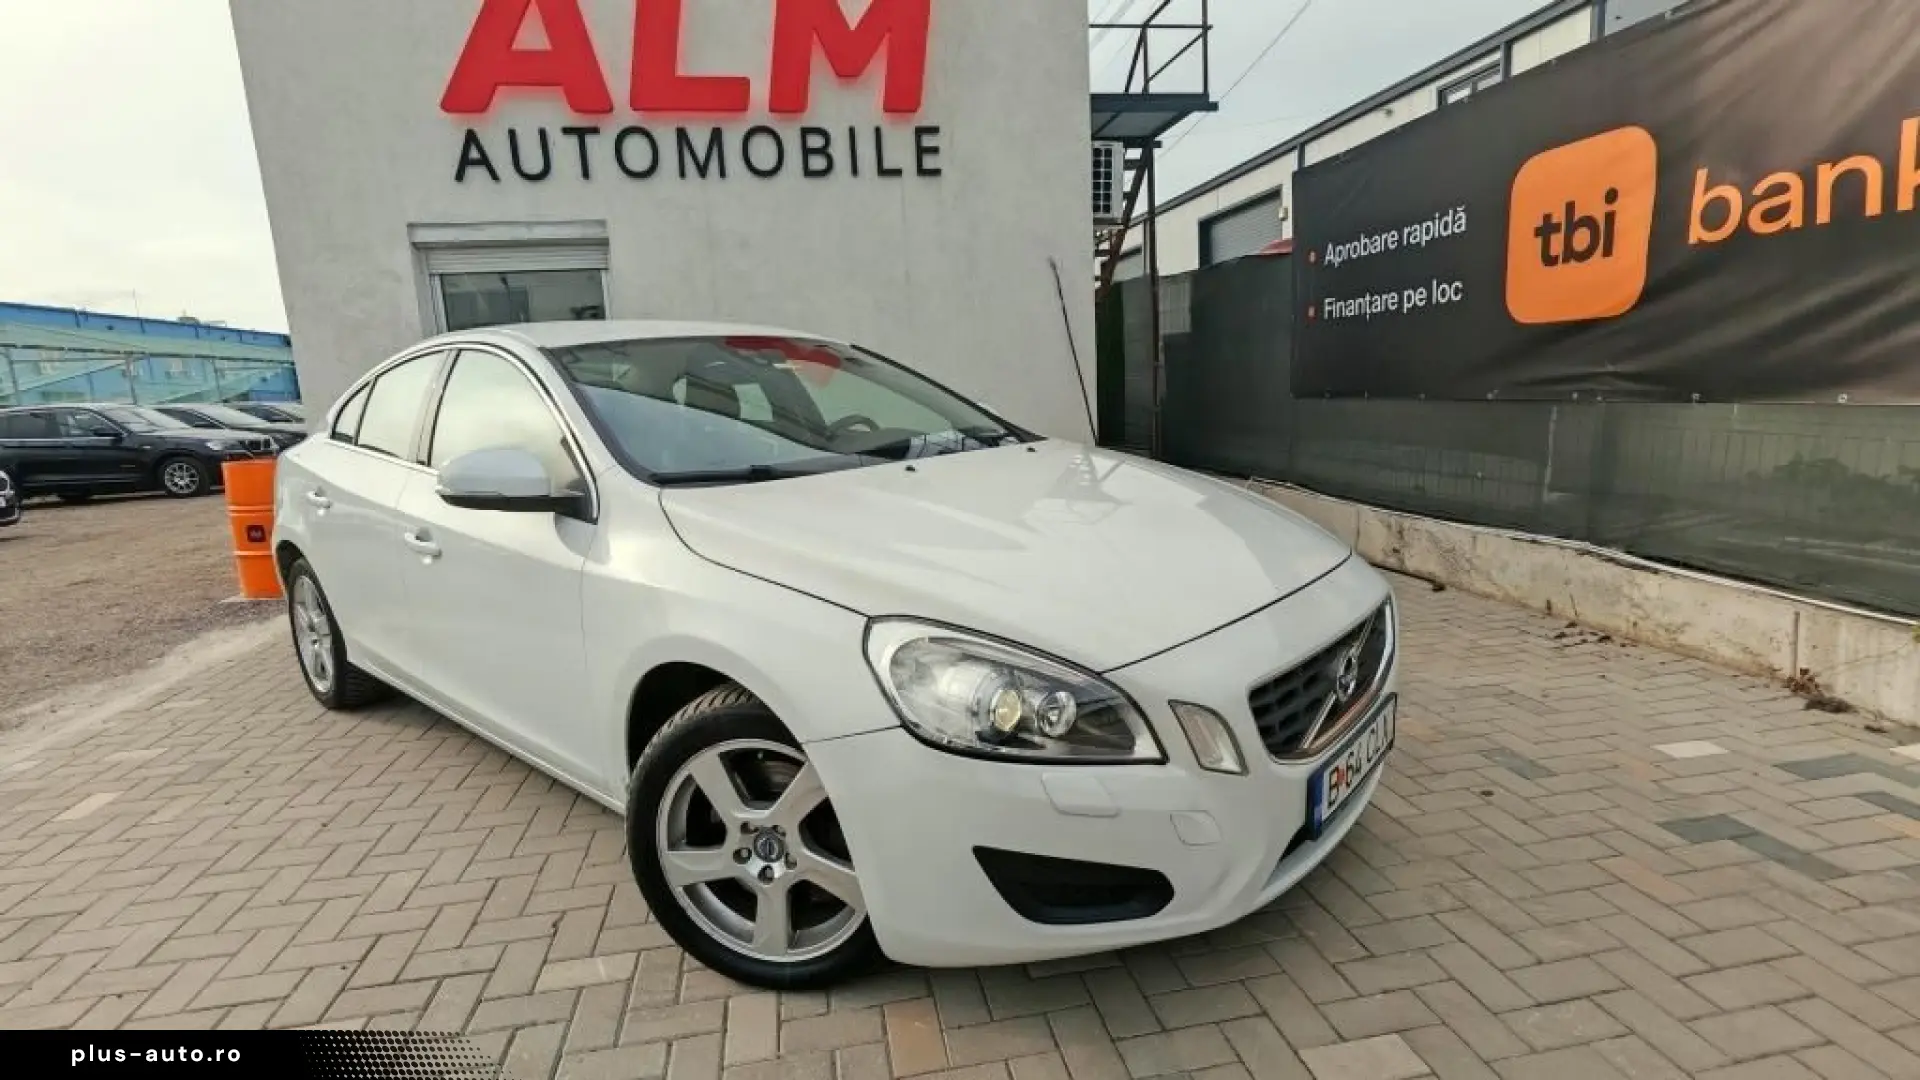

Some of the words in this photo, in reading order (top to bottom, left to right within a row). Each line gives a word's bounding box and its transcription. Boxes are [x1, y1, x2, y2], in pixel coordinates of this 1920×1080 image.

[439, 0, 930, 113] ALM
[455, 125, 942, 182] AUTOMOBILE
[1323, 229, 1399, 268] Aprobare
[1403, 204, 1467, 248] rapidă
[1533, 186, 1619, 267] tbi
[1403, 286, 1427, 314] pe
[1432, 278, 1463, 305] loc
[1328, 764, 1340, 809] B
